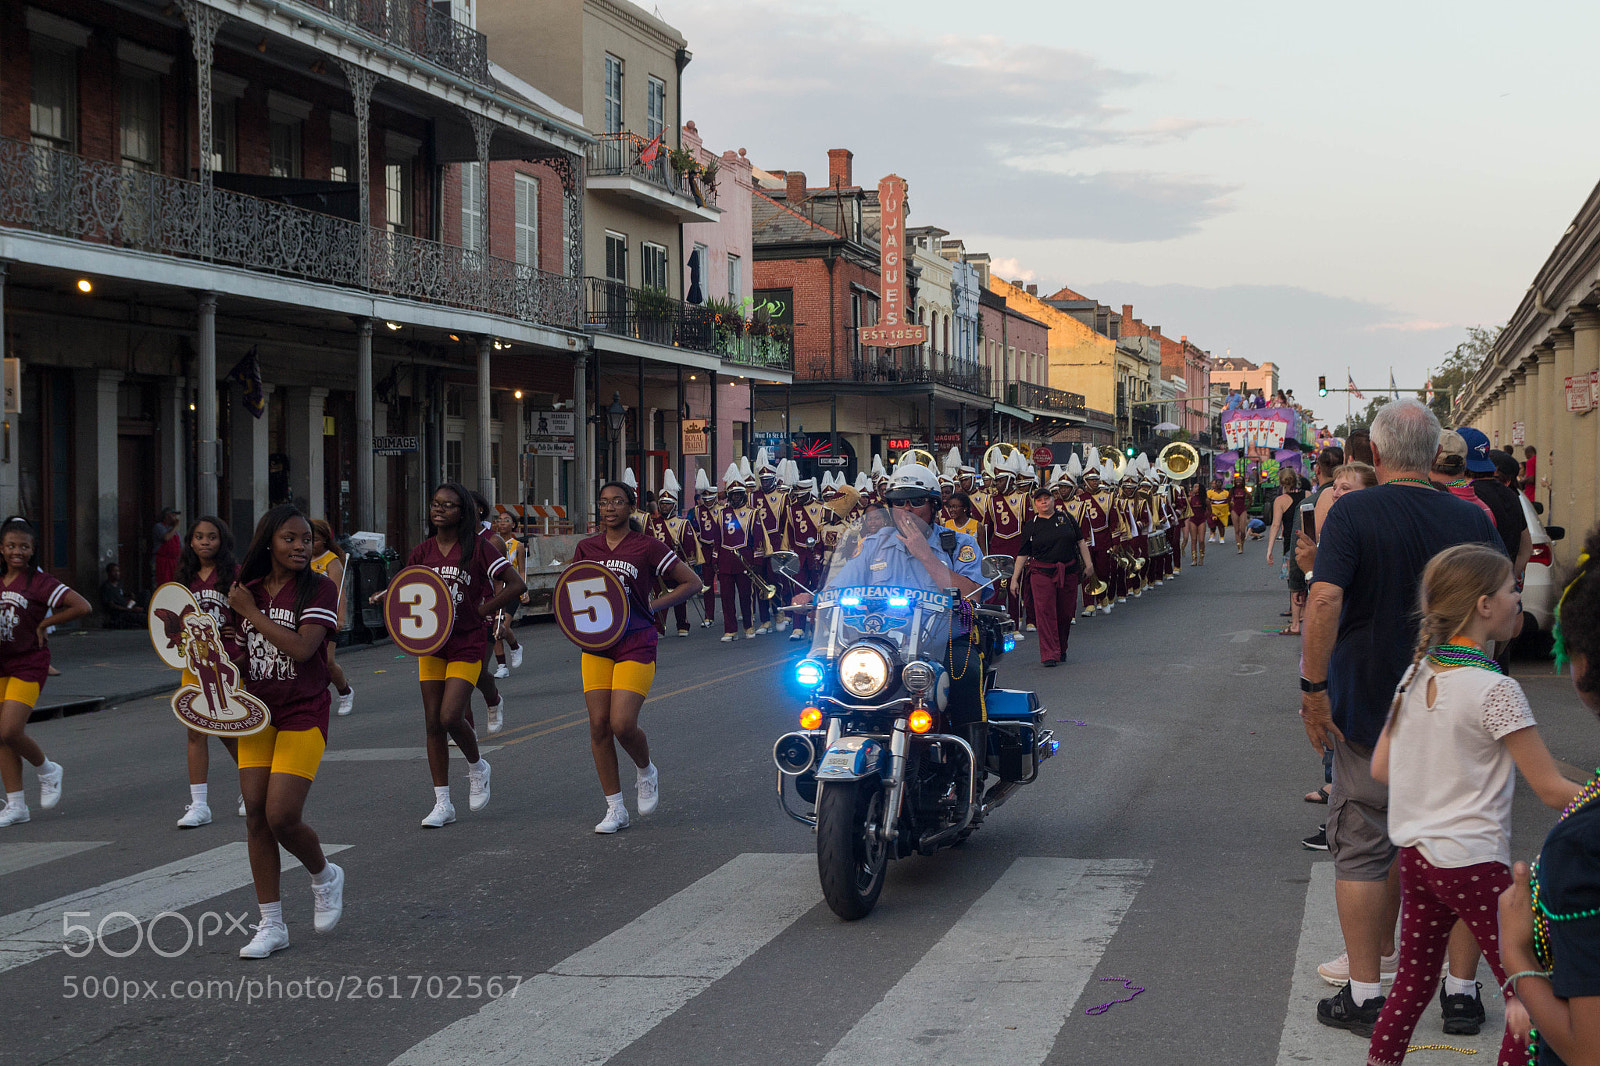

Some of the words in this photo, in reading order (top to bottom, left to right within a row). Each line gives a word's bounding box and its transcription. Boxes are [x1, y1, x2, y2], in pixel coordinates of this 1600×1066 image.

[886, 181, 899, 325] TUJAGUE'S
[890, 329, 922, 340] 1856
[372, 437, 384, 448] RO
[385, 437, 416, 449] IMAGE
[890, 439, 910, 449] BAR
[816, 589, 842, 603] NEW
[842, 586, 900, 598] ORLEANS
[904, 588, 950, 607] POLICE
[399, 581, 439, 641] 3
[566, 576, 614, 634] 5
[269, 608, 296, 624] CARRI
[208, 721, 244, 730] SENIOR
